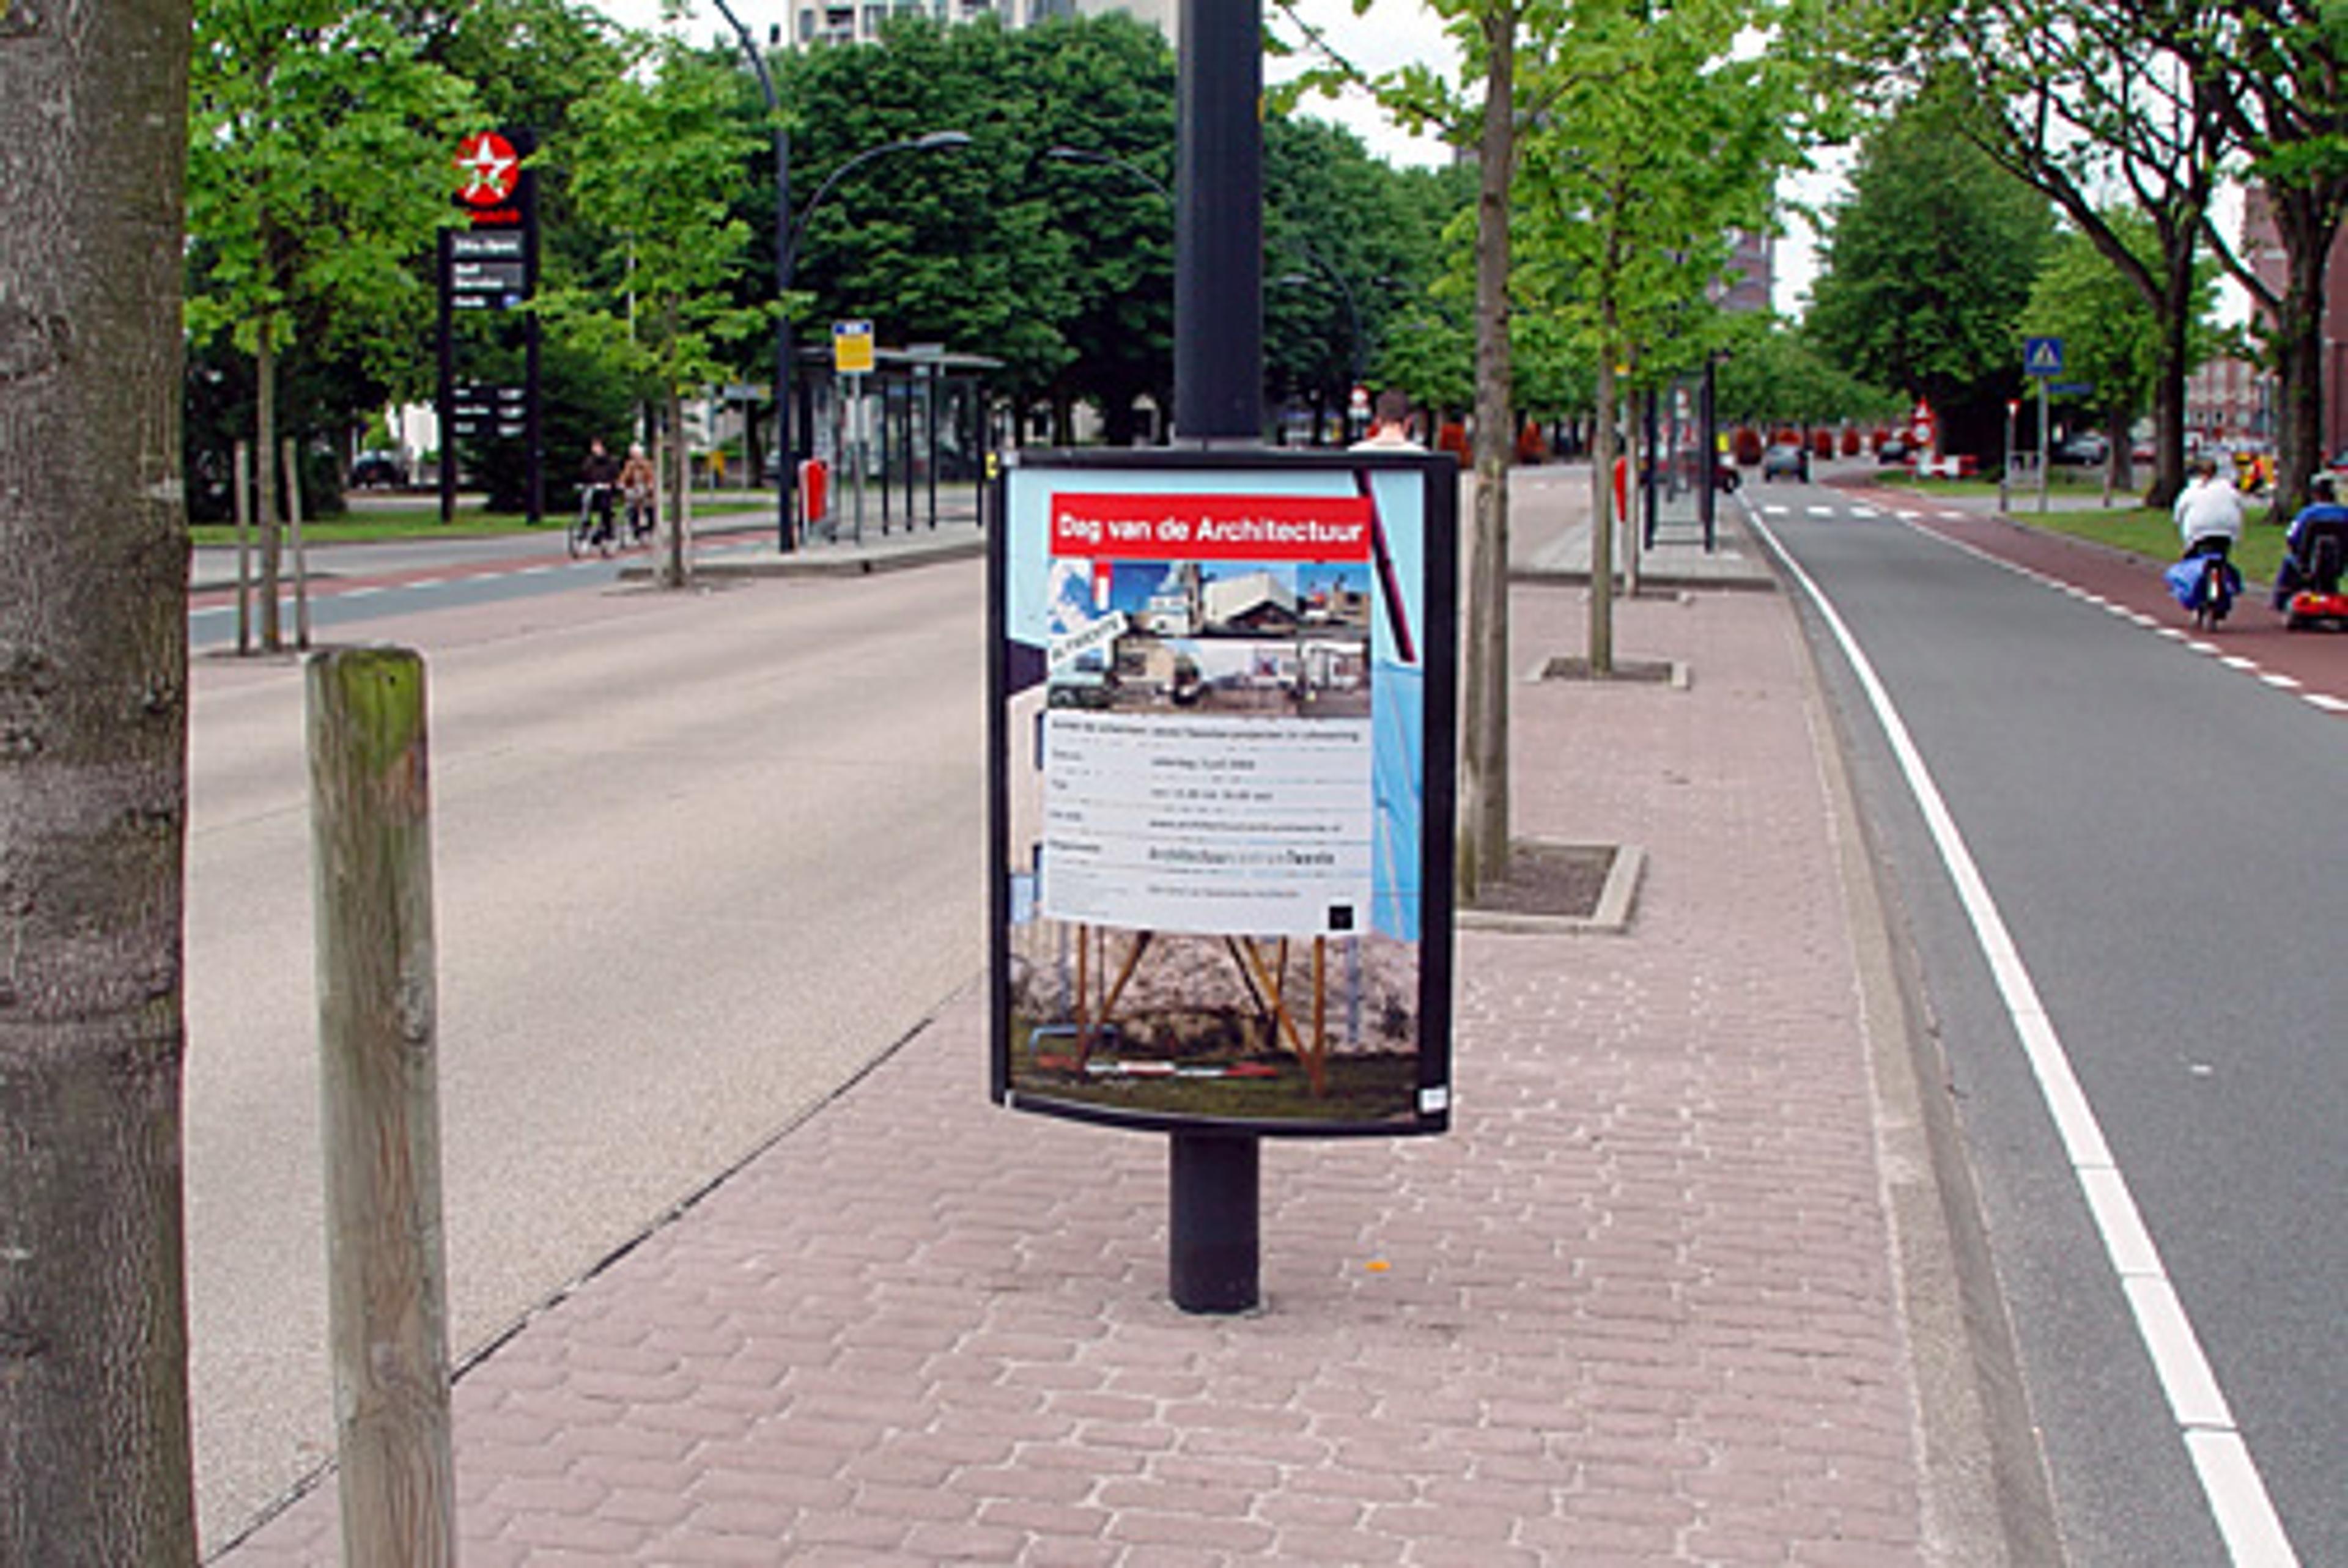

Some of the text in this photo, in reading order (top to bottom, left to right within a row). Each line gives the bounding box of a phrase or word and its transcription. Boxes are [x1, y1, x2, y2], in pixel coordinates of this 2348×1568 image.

[1060, 512, 1363, 544] Dag van de Architectuur
